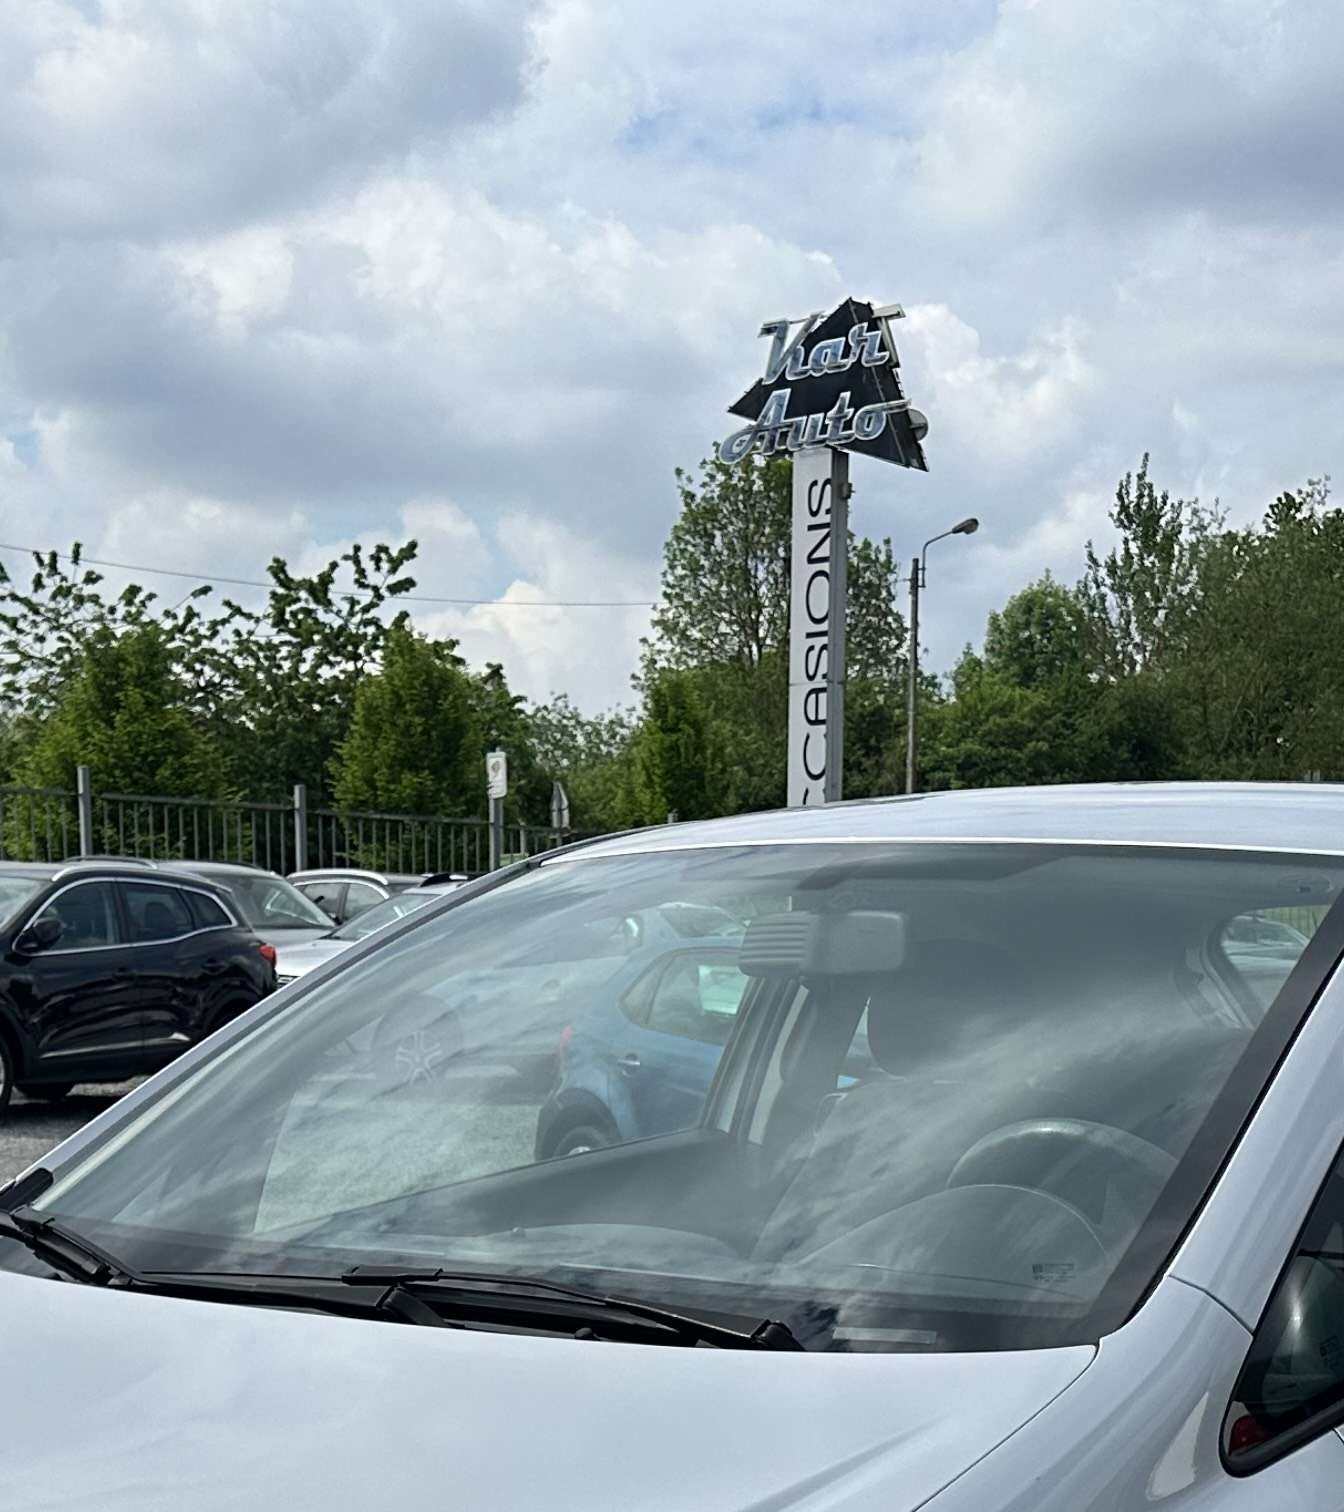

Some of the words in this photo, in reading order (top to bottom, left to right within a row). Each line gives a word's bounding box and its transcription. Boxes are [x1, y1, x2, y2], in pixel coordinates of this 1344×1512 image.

[759, 314, 889, 383] Kar
[720, 389, 911, 463] Auto
[803, 477, 833, 806] CASIONS
